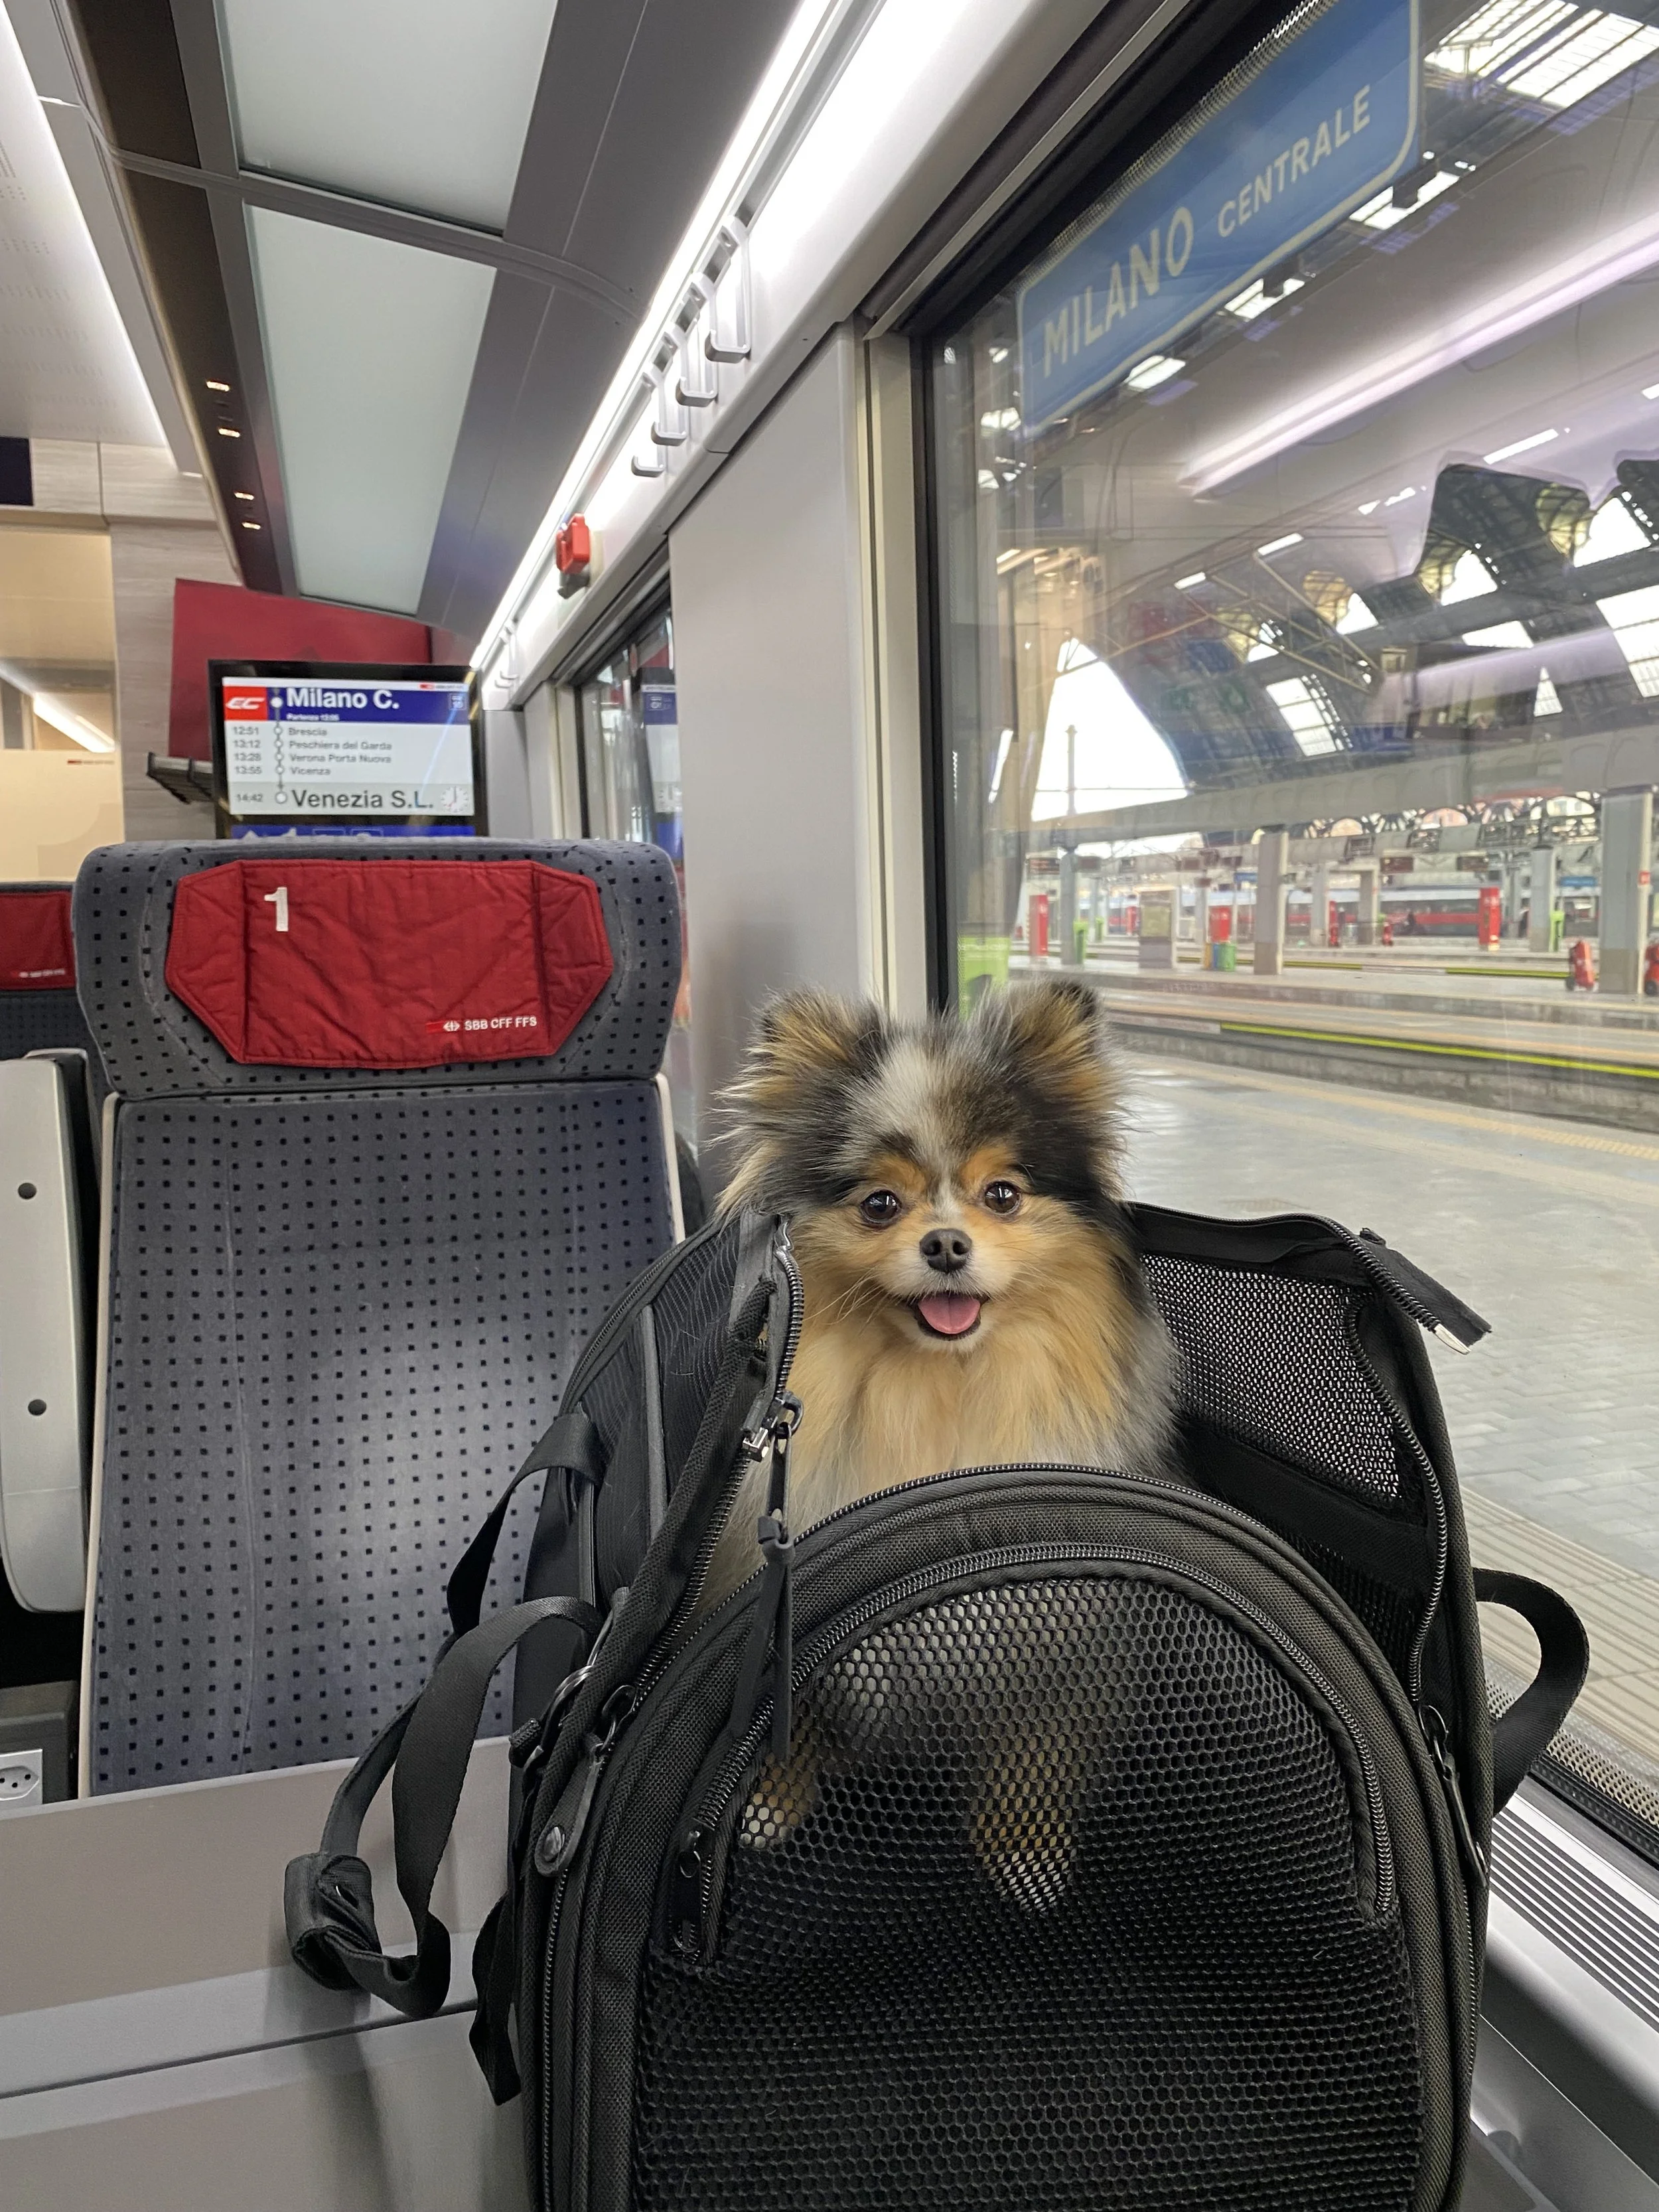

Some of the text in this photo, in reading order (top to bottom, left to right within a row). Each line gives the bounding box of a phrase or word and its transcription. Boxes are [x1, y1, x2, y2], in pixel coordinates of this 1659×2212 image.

[1043, 84, 1371, 378] MILANO CENTRALE
[286, 688, 399, 709] Milano C.
[289, 727, 327, 736] Brescia
[289, 740, 340, 750] Peschiera
[342, 741, 358, 749] del
[361, 741, 392, 750] Garda
[290, 754, 325, 763] Verona
[328, 754, 356, 763] Porta
[360, 755, 392, 763] Nuova
[291, 767, 330, 775] Vicenza
[291, 789, 383, 808] Venezia
[391, 790, 434, 808] S.L.
[264, 886, 289, 932] 1
[465, 1015, 538, 1031] SBB CFF FFS
